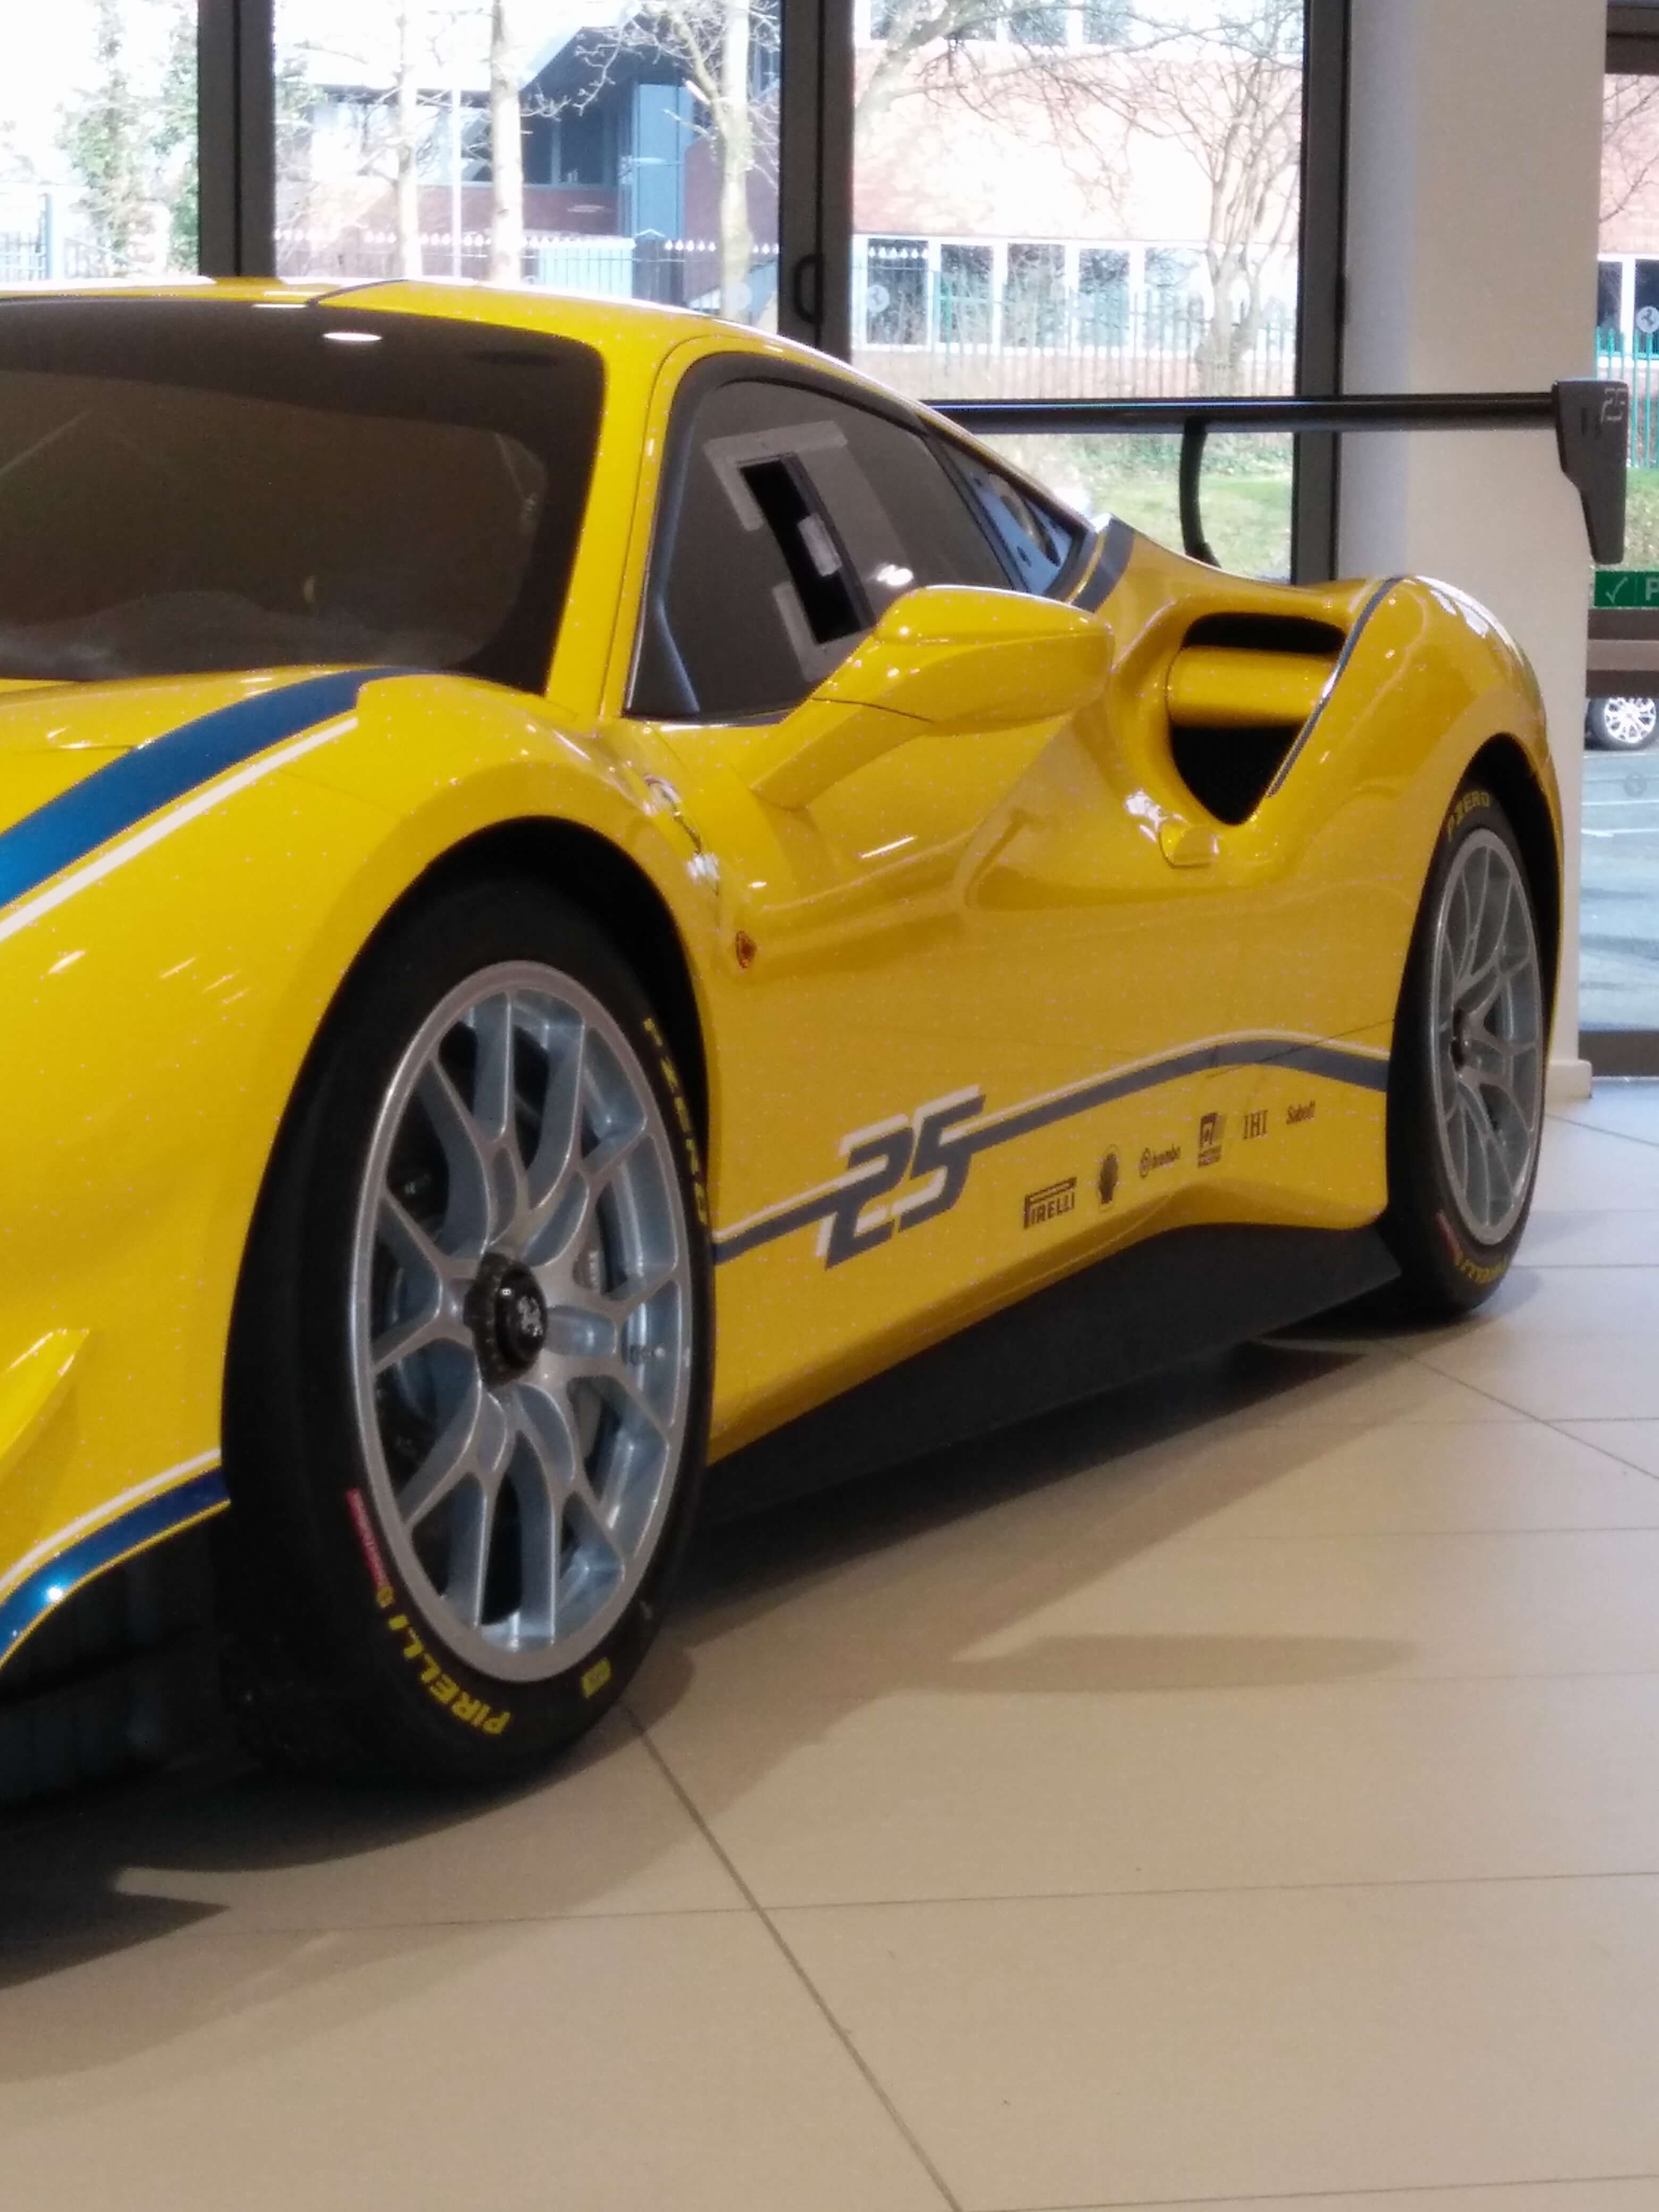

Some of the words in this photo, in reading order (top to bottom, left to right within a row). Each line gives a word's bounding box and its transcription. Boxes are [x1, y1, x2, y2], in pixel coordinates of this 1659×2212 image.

[1243, 1109, 1268, 1139] IHI
[814, 1084, 986, 1270] 25
[1023, 1177, 1077, 1230] PIRELLI
[388, 1613, 511, 1735] PIRELLI
